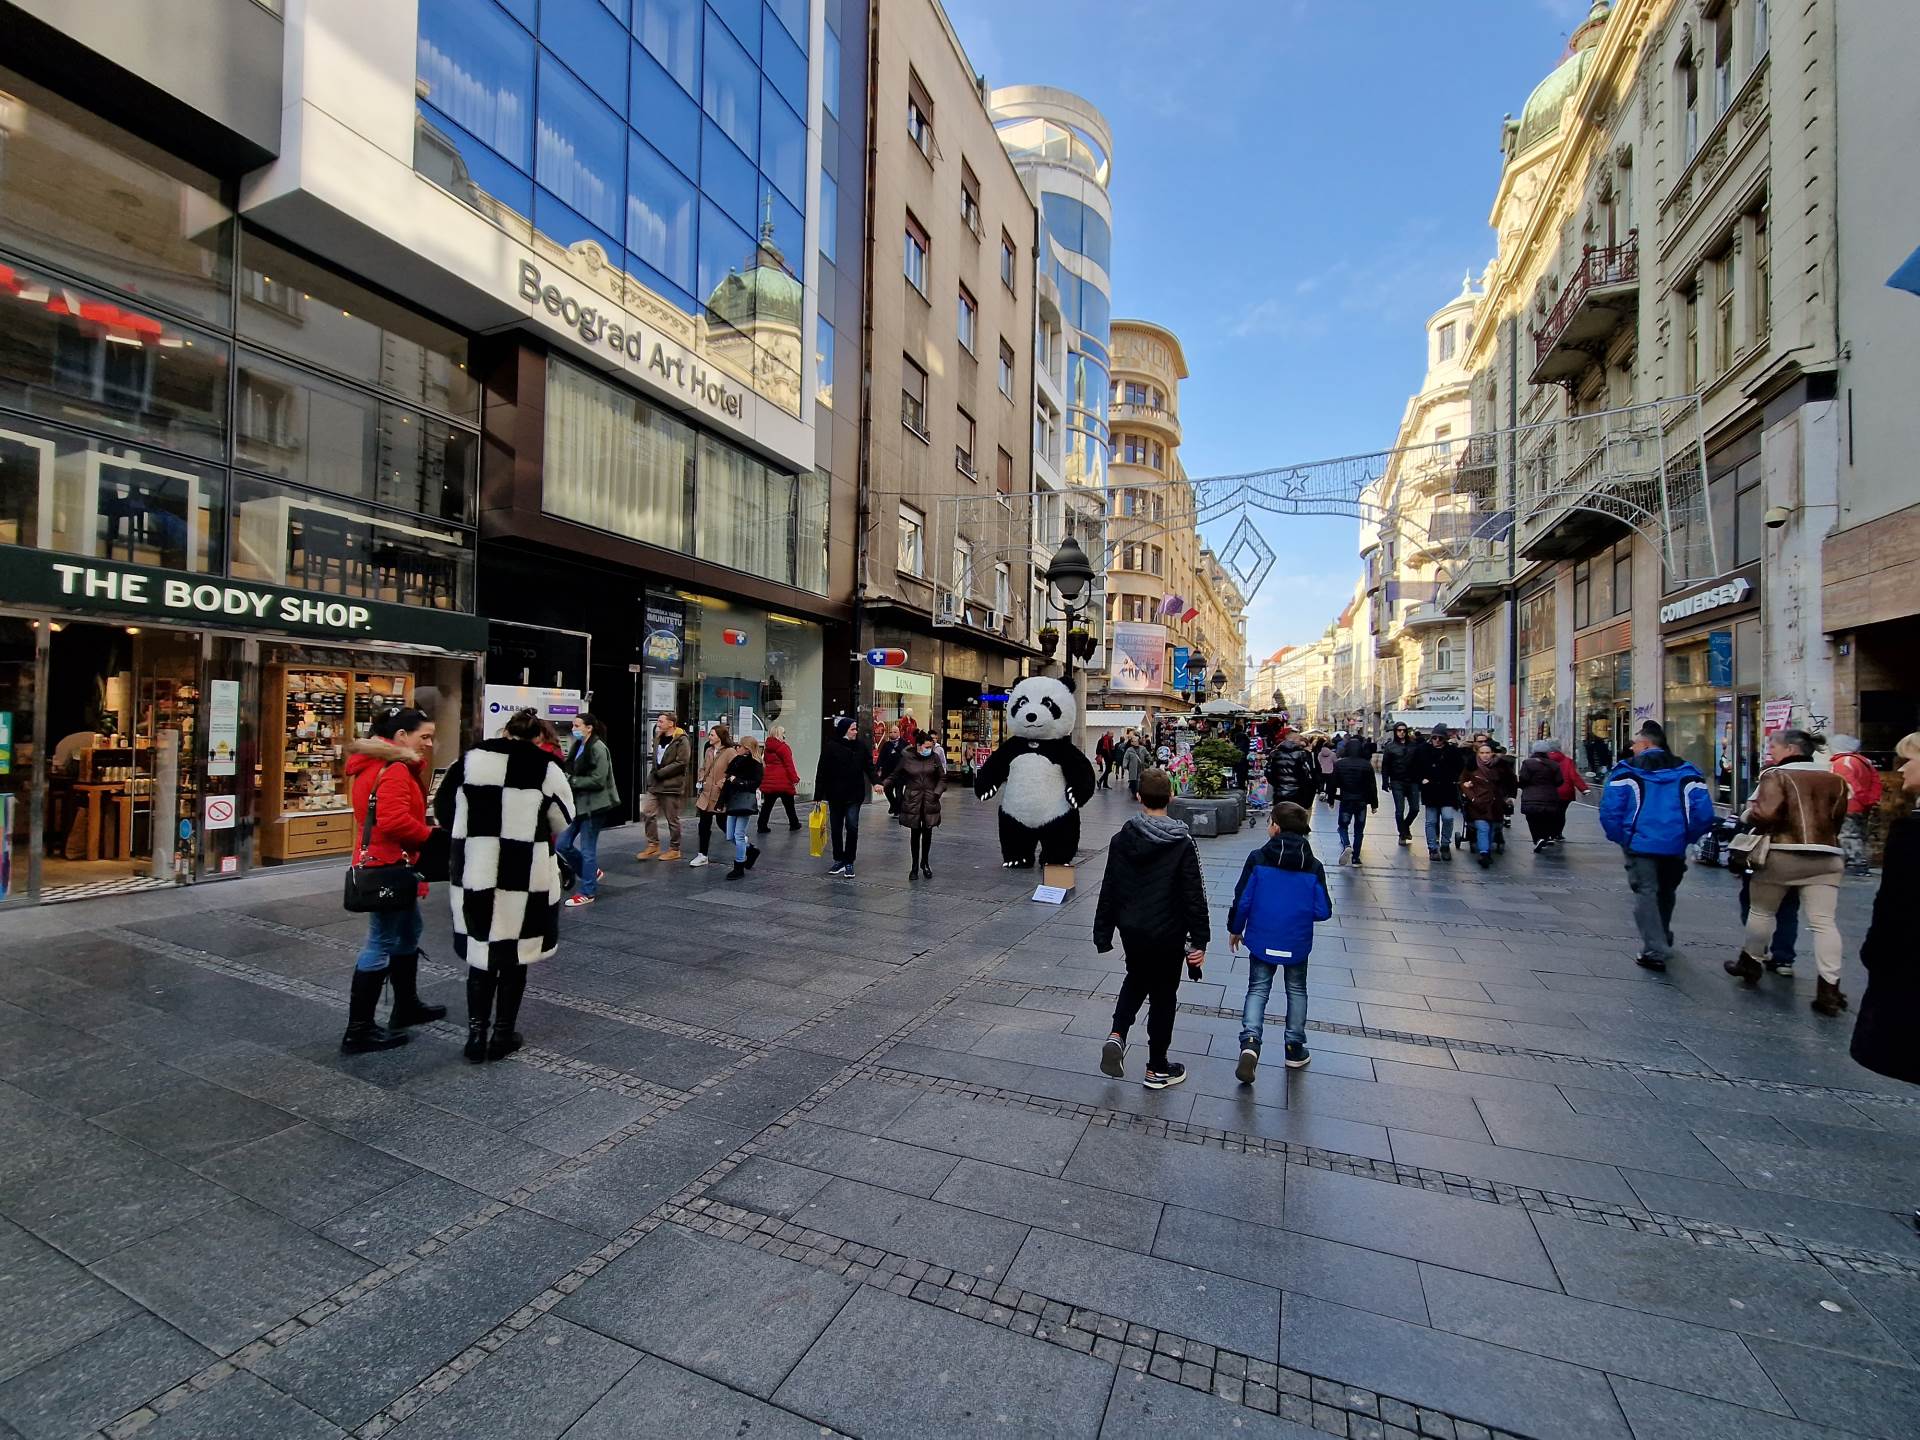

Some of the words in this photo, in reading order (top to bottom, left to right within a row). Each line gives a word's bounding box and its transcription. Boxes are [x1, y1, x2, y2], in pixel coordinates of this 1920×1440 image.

[518, 258, 642, 362] Beograd
[648, 342, 686, 389] Art
[691, 364, 743, 419] Hotel
[53, 563, 149, 604] THE
[164, 579, 273, 618] BODY
[280, 596, 373, 631] SHOP.
[1660, 583, 1735, 624] CONVERSE
[647, 613, 683, 627] IMUNITETU
[501, 704, 515, 712] NLB
